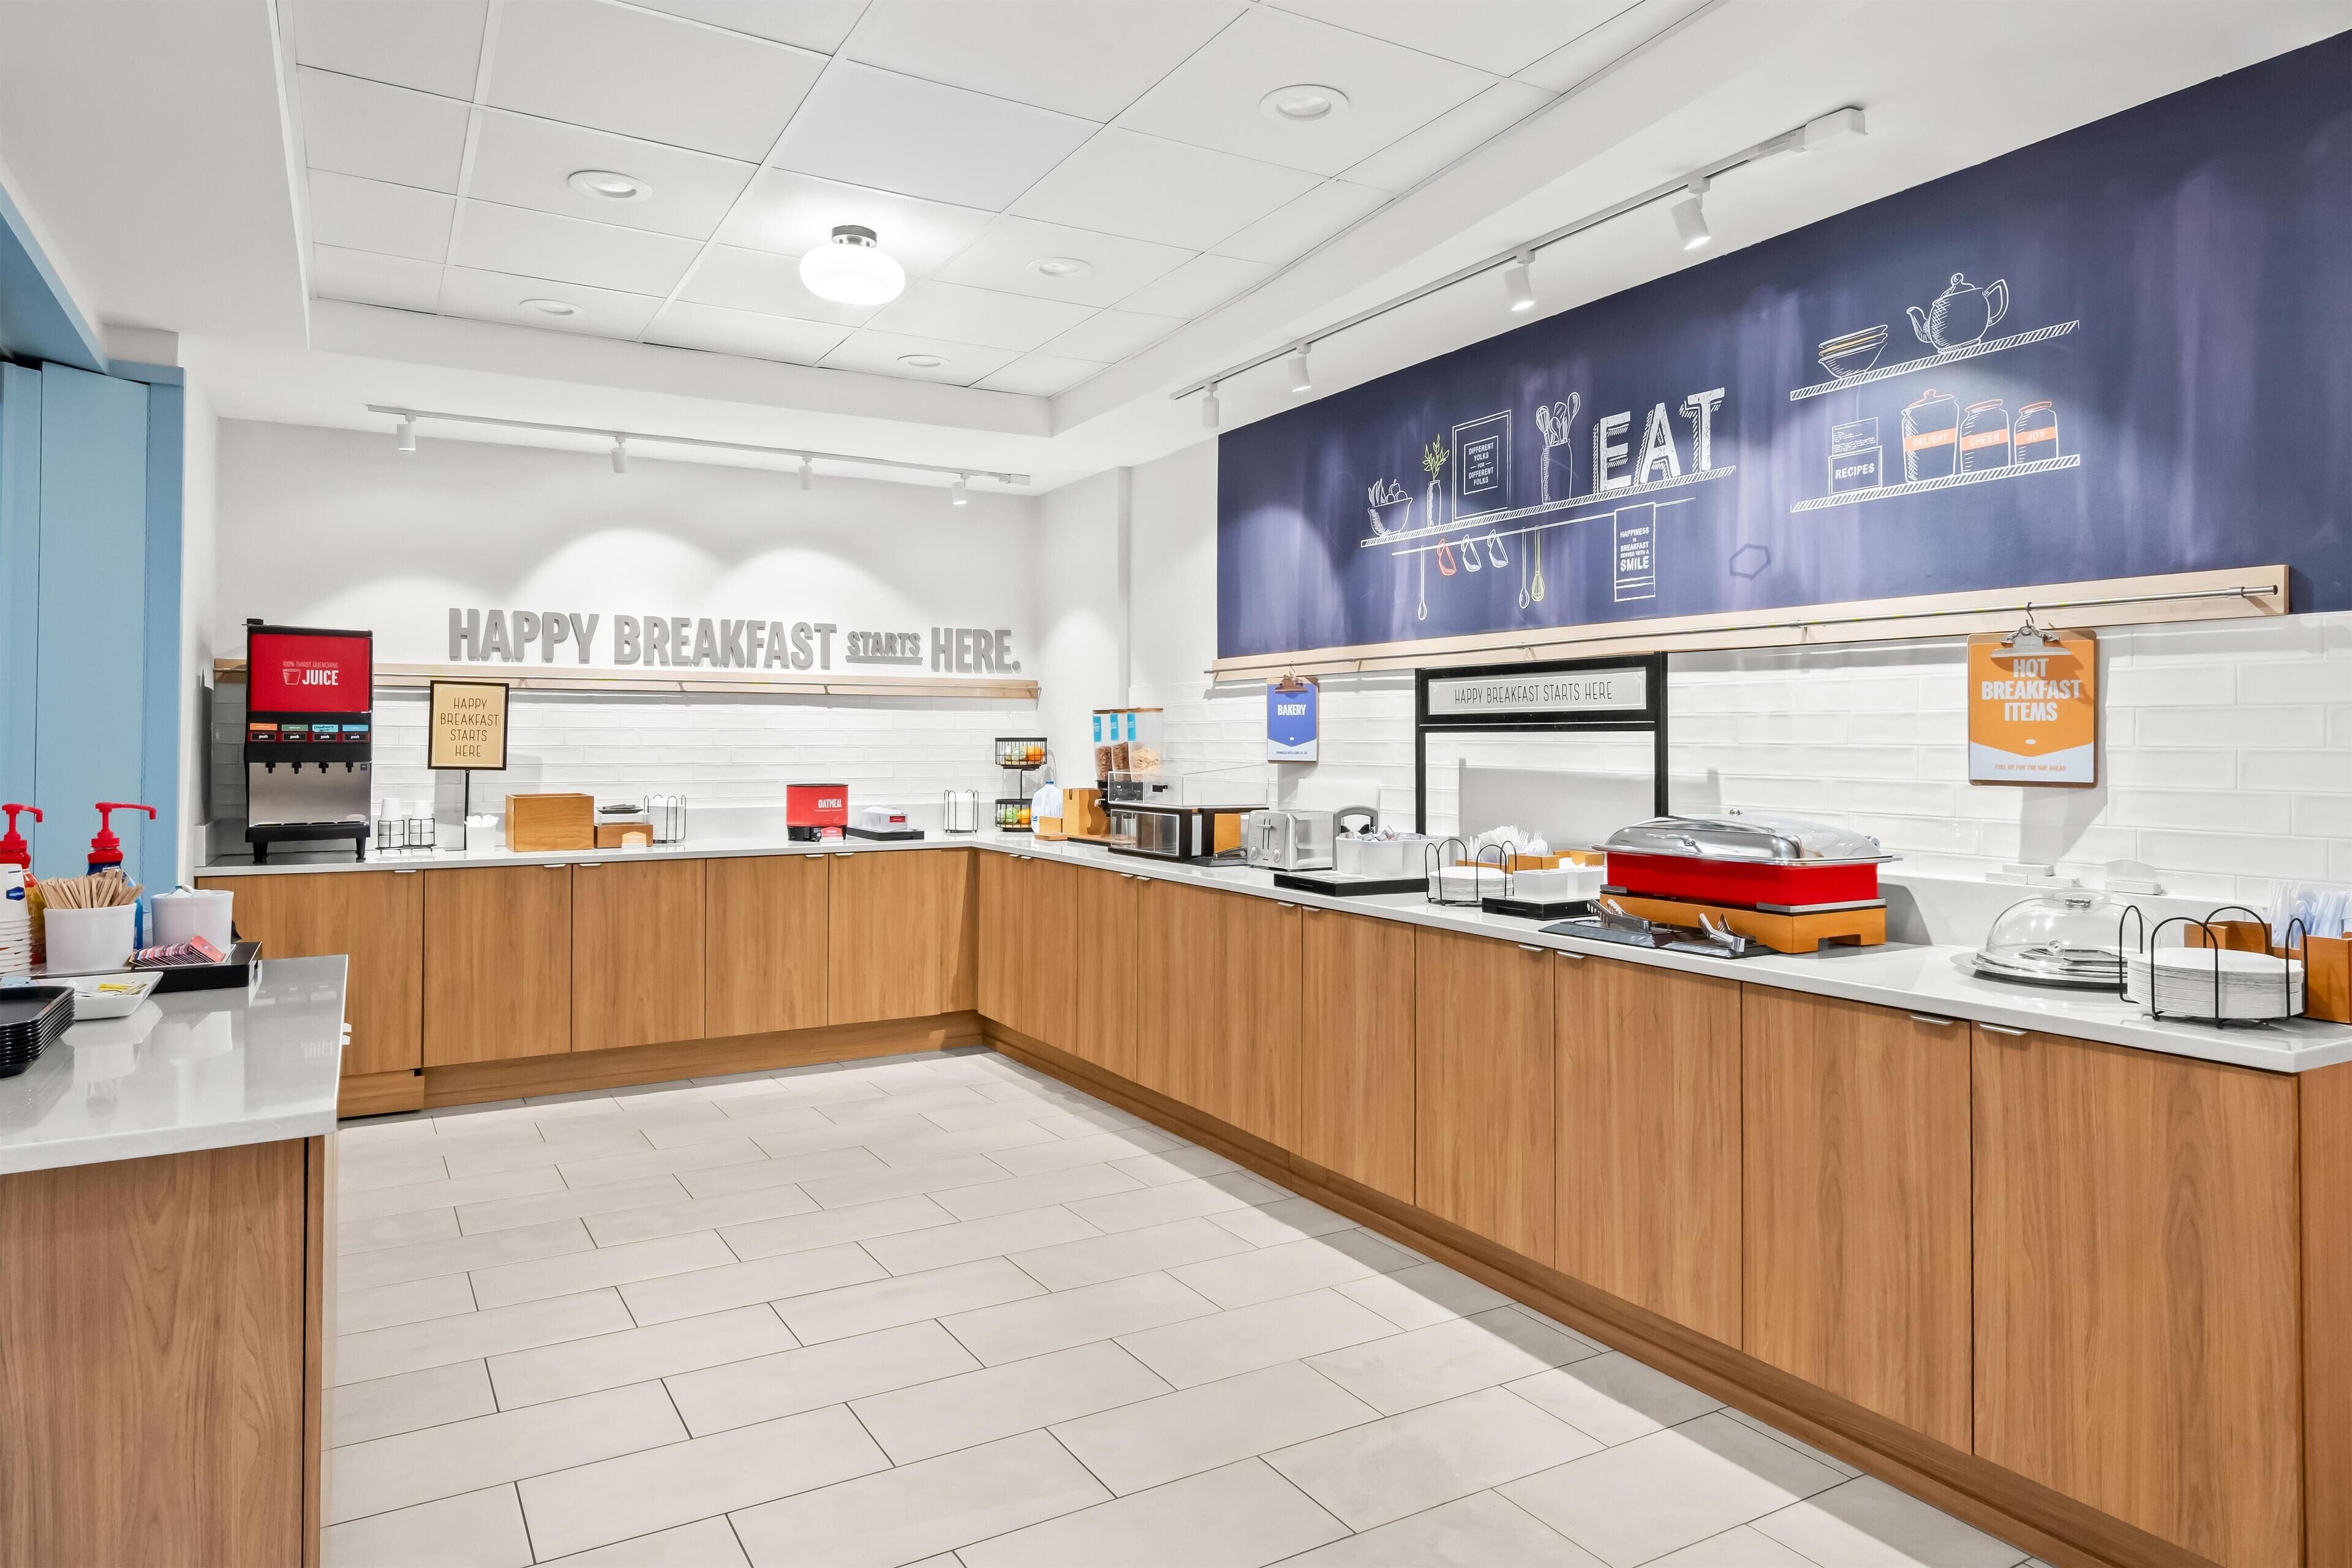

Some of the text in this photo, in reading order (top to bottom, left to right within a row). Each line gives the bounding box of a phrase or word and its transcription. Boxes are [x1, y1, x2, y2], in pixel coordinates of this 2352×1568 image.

[1593, 387, 1725, 493] EAT
[1912, 432, 1948, 448] DELIGHT
[1970, 433, 1999, 446] CHEER
[2027, 430, 2045, 442] JOY
[1469, 442, 1494, 455] DIFFERENT
[1474, 451, 1489, 461] YOLKS
[1469, 466, 1494, 479] DIFFERENT
[1835, 463, 1874, 480] RECIPES
[1473, 476, 1489, 486] FOLKS
[1620, 527, 1649, 538] HAPPINESS
[1620, 541, 1649, 552] BREAKFAST
[1620, 555, 1649, 572] SMILE
[449, 608, 1022, 674] HAPPY BREAKFAST STARTS HERE.
[2013, 658, 2049, 678] HOT
[302, 669, 339, 685] JUICE
[1455, 681, 1612, 704] HAPPY BREAKFAST STARTS HERE
[1981, 679, 2082, 700] BREAKFAST
[454, 698, 487, 710] HAPPY
[1278, 704, 1306, 715] BAKERY
[2005, 702, 2058, 722] ITEMS
[440, 713, 499, 726] BREAKFAST
[450, 729, 488, 741] STARTS
[455, 745, 481, 757] HERE
[818, 799, 842, 809] OATMEAL
